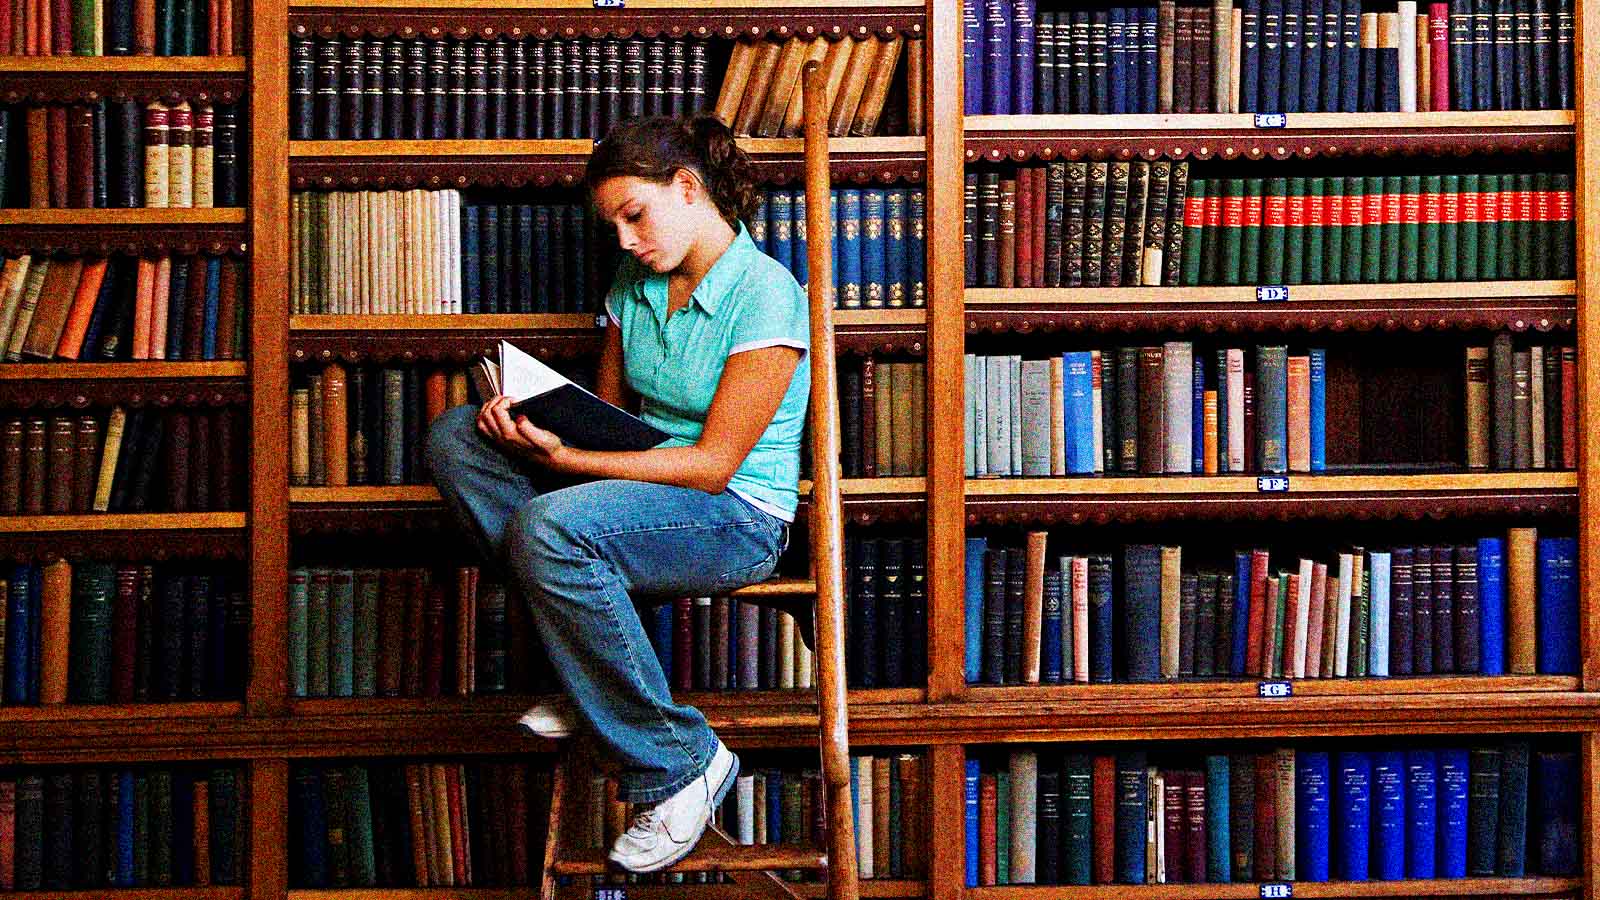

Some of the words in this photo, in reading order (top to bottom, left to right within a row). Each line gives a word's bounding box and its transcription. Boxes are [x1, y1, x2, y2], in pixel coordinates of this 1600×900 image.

[1268, 290, 1278, 298] D
[1270, 480, 1279, 489] F
[1270, 686, 1279, 694] G
[1271, 887, 1280, 896] H
